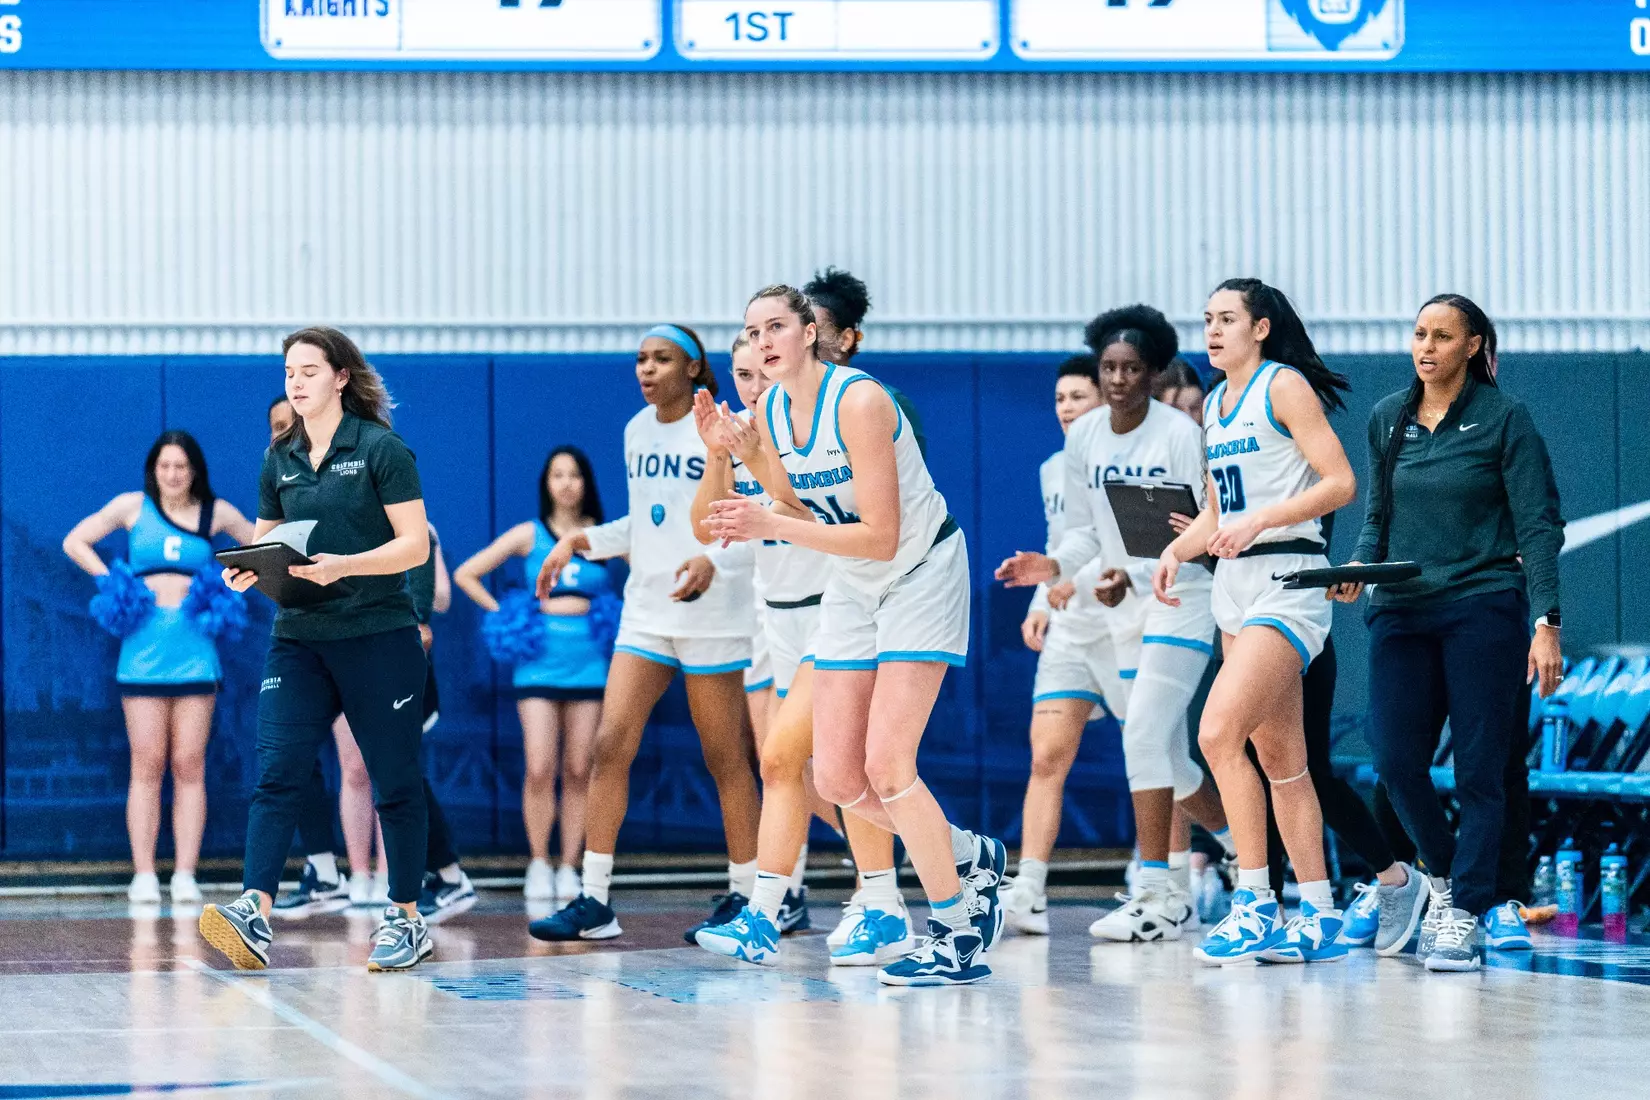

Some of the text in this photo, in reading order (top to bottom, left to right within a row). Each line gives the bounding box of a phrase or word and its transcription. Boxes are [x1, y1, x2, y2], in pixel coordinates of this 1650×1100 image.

[725, 11, 794, 42] 1ST
[1211, 465, 1246, 515] 20
[164, 535, 182, 562] C
[561, 562, 581, 588] C
